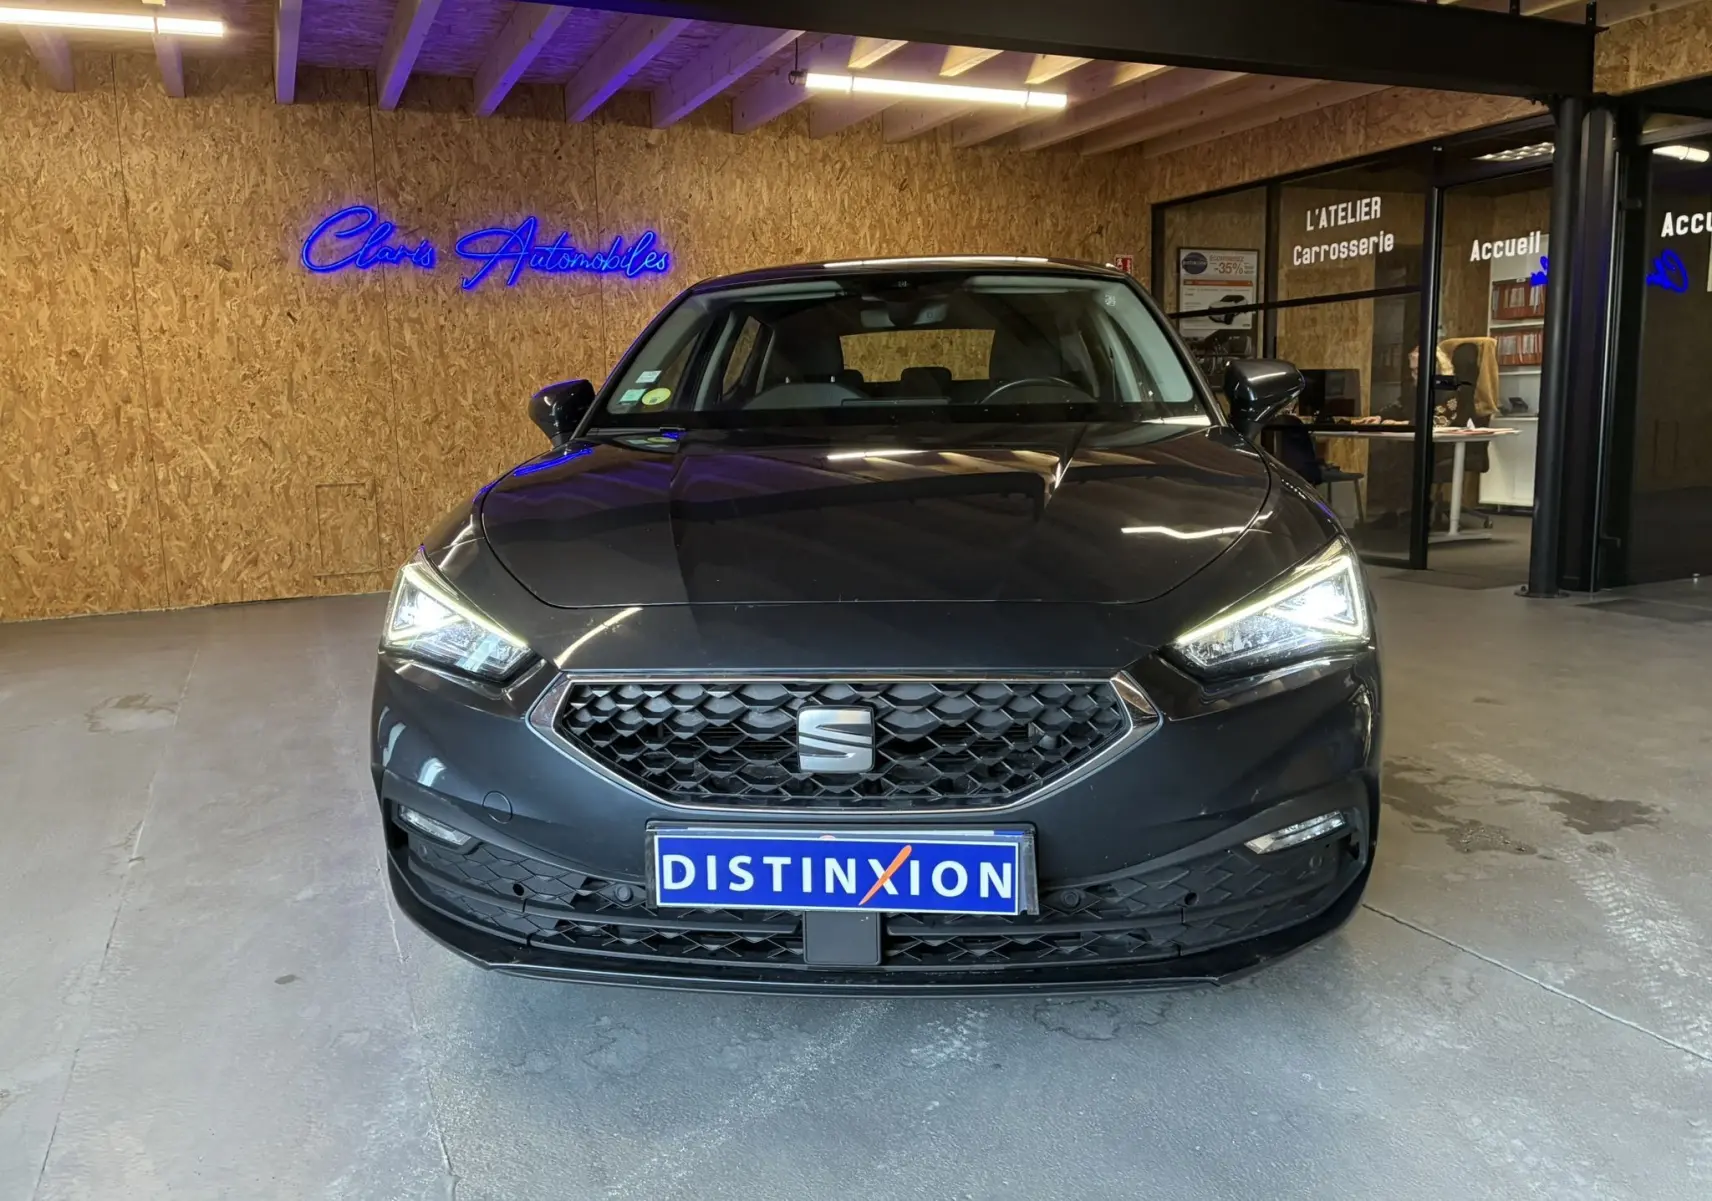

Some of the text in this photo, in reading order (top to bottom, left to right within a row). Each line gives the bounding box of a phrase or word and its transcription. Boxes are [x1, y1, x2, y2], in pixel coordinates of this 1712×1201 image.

[1306, 196, 1381, 232] L'ATELIER
[302, 206, 669, 289] Claris Automobiles
[1293, 230, 1394, 266] Carrosserie
[1469, 230, 1541, 262] Accueil
[1214, 262, 1244, 275] -35%
[662, 845, 1012, 906] DISTINXION
